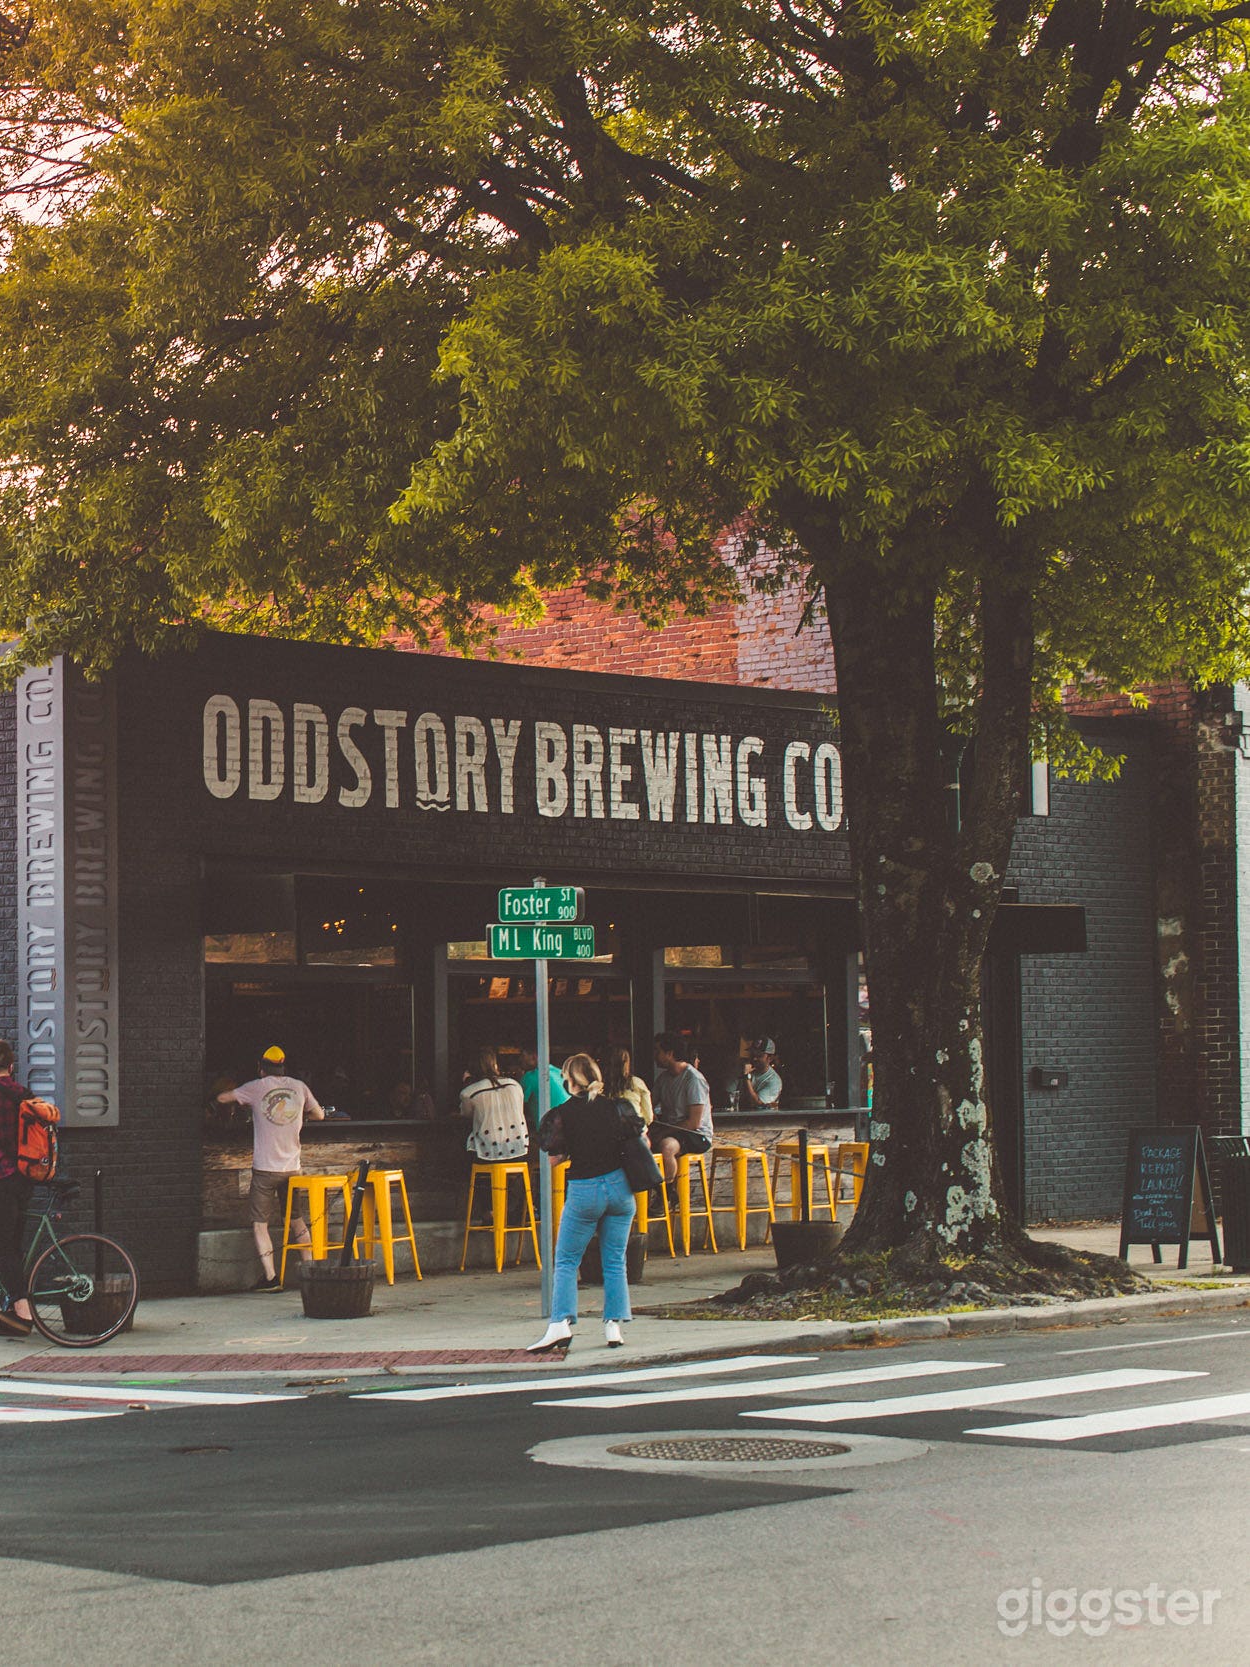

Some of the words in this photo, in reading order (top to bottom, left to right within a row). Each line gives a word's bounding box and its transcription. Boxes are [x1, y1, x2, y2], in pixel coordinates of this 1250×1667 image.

[203, 694, 522, 814] ODDSTORY
[535, 721, 768, 828] BREWING
[784, 741, 849, 831] CO
[26, 741, 55, 907] BREWING
[75, 743, 108, 907] BREWING
[504, 893, 551, 915] Foster
[560, 888, 571, 901] ST
[533, 927, 563, 957] King
[573, 927, 592, 941] BLVD
[557, 905, 575, 919] 900
[576, 944, 591, 957] 400
[75, 920, 109, 1117] ODDSTORY
